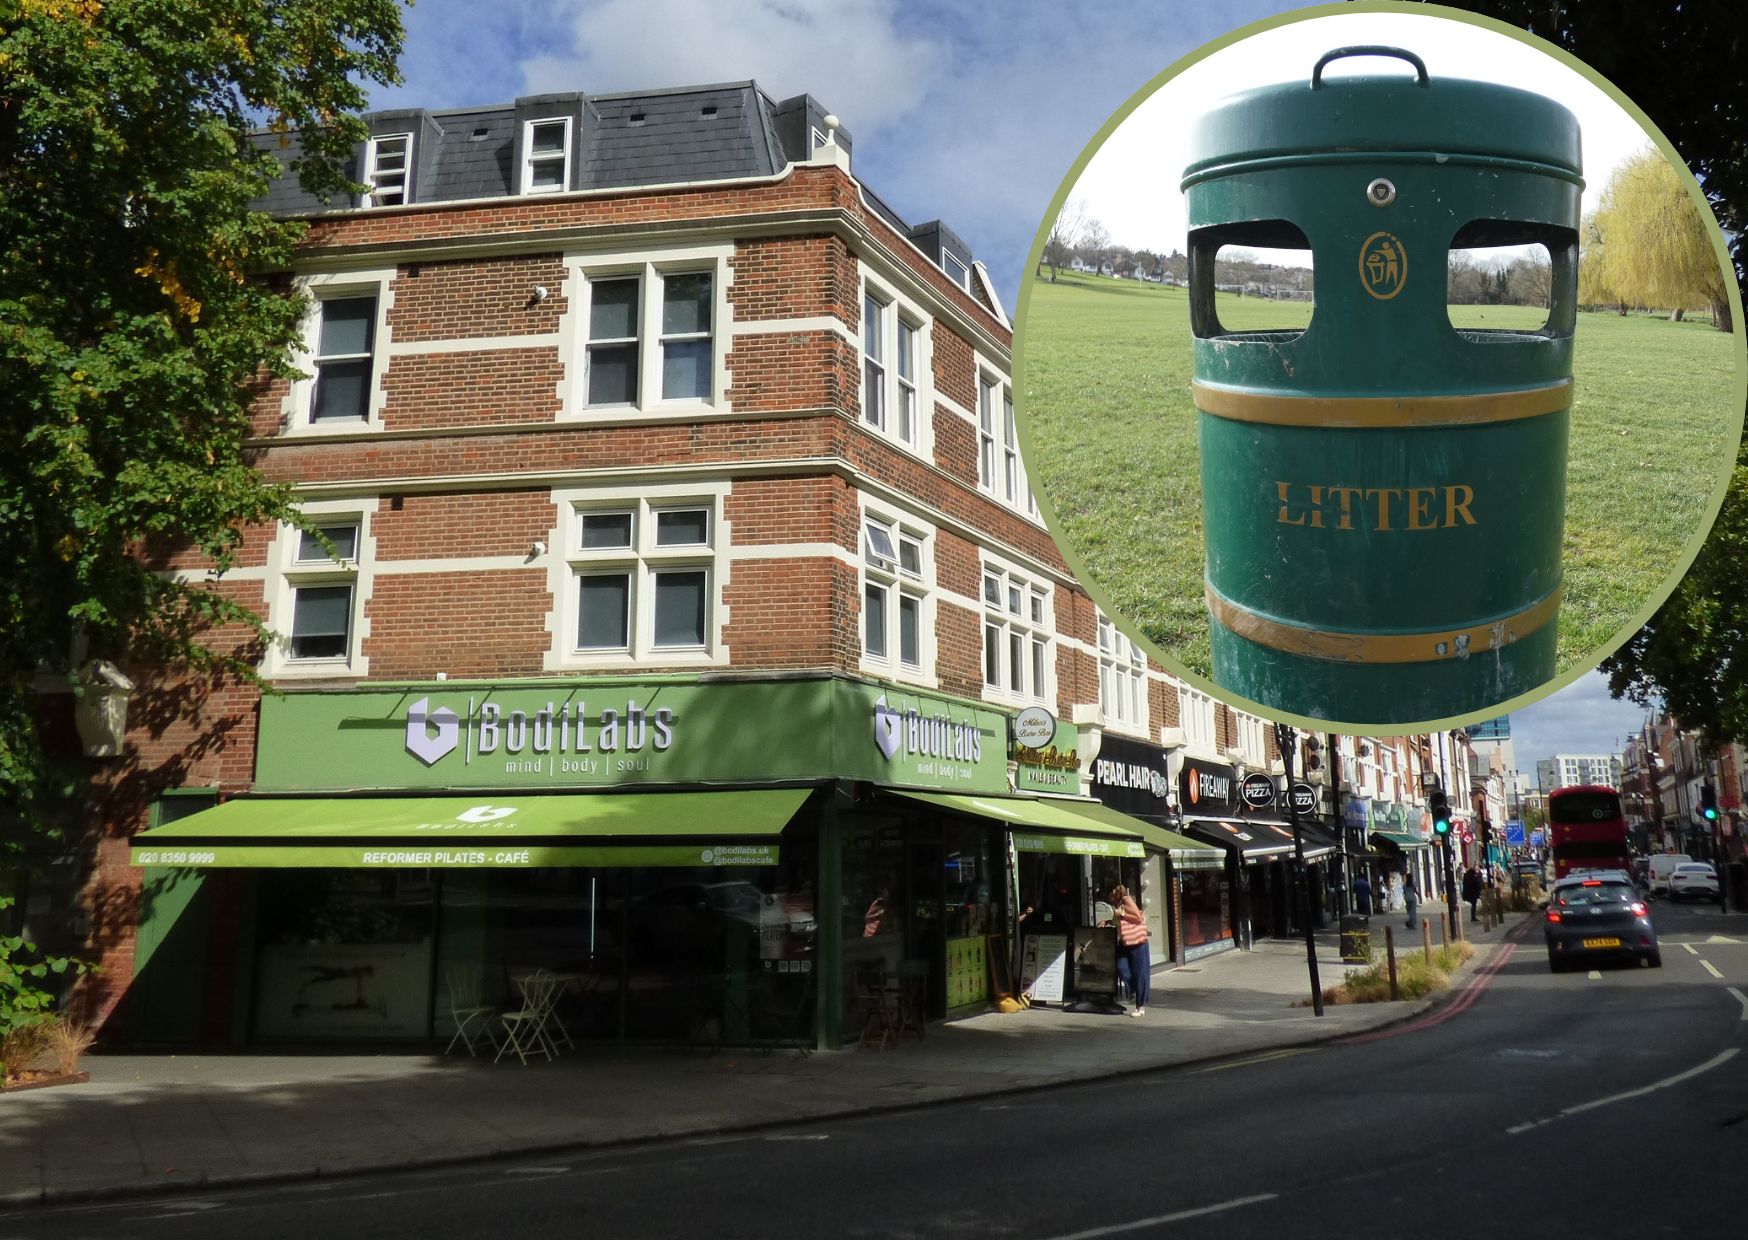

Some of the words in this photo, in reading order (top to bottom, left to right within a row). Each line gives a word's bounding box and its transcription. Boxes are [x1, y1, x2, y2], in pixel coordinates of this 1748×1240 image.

[1275, 481, 1478, 531] LITTER
[478, 700, 673, 752] BodiLabs
[506, 757, 541, 774] mind
[562, 757, 597, 775] body
[617, 756, 650, 771] soul
[1097, 759, 1128, 786] PEARL
[1129, 764, 1151, 790] HAIR
[1200, 773, 1230, 805] FIREAWAY
[1246, 788, 1272, 798] PIZZA
[1295, 797, 1313, 805] IZZA
[139, 852, 159, 863] 020
[160, 852, 187, 864] 8350
[188, 852, 215, 864] 9999
[363, 852, 432, 864] REFORMER
[434, 852, 485, 864] PILATES
[495, 850, 529, 864] CAFÉ
